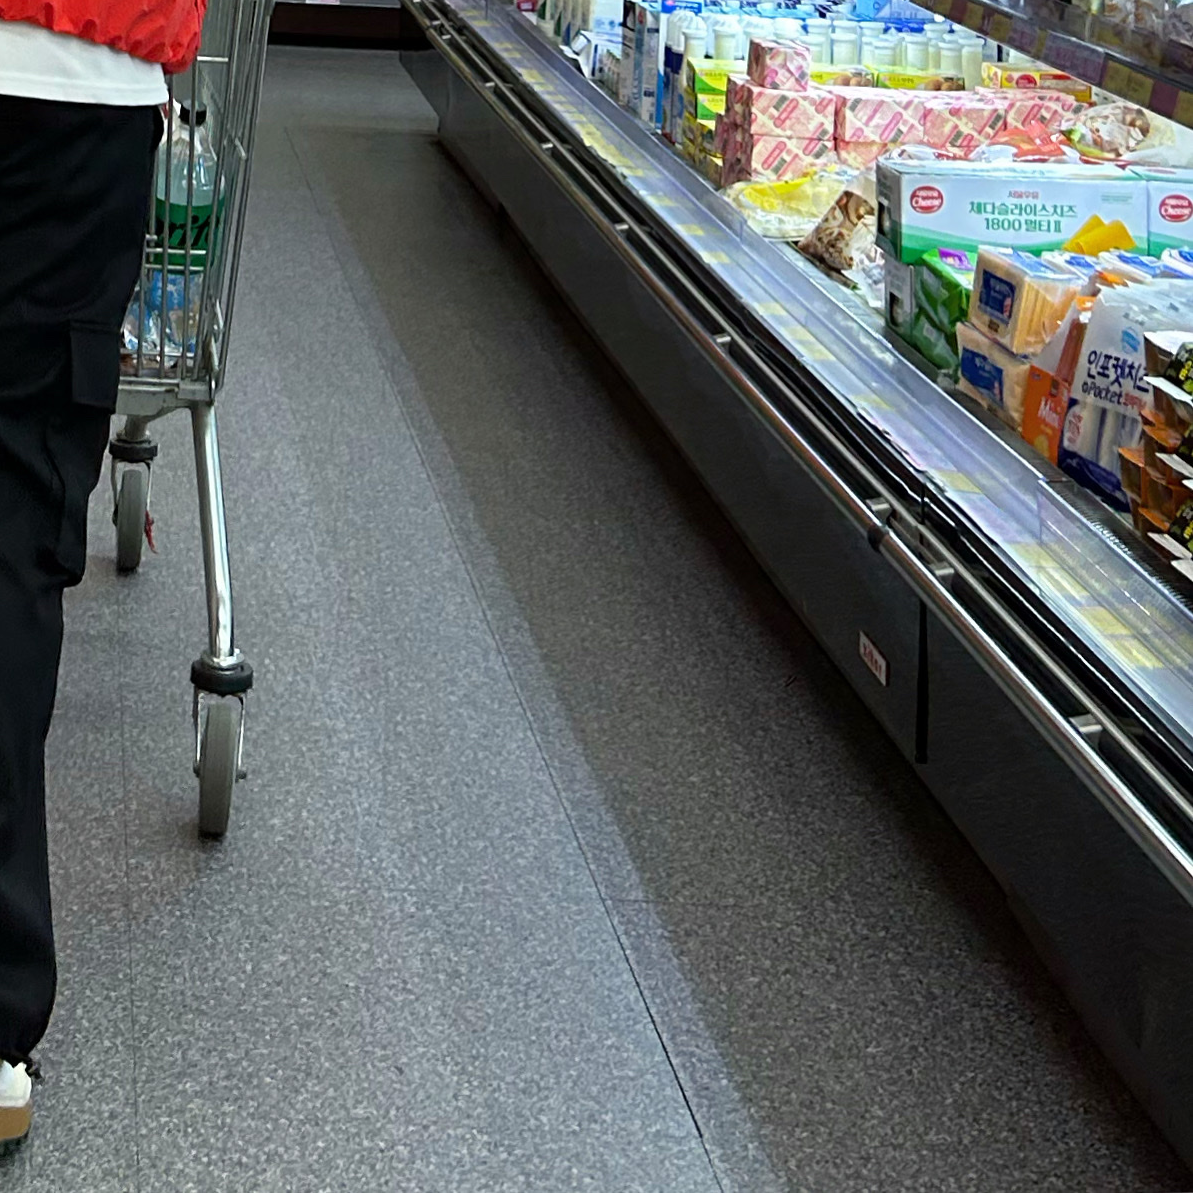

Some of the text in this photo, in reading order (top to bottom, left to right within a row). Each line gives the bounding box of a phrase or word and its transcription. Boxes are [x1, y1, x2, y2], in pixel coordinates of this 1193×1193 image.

[969, 201, 1078, 218] 체다슬라이스치즈
[984, 217, 1022, 231] 1800
[1024, 219, 1051, 233] 멀티
